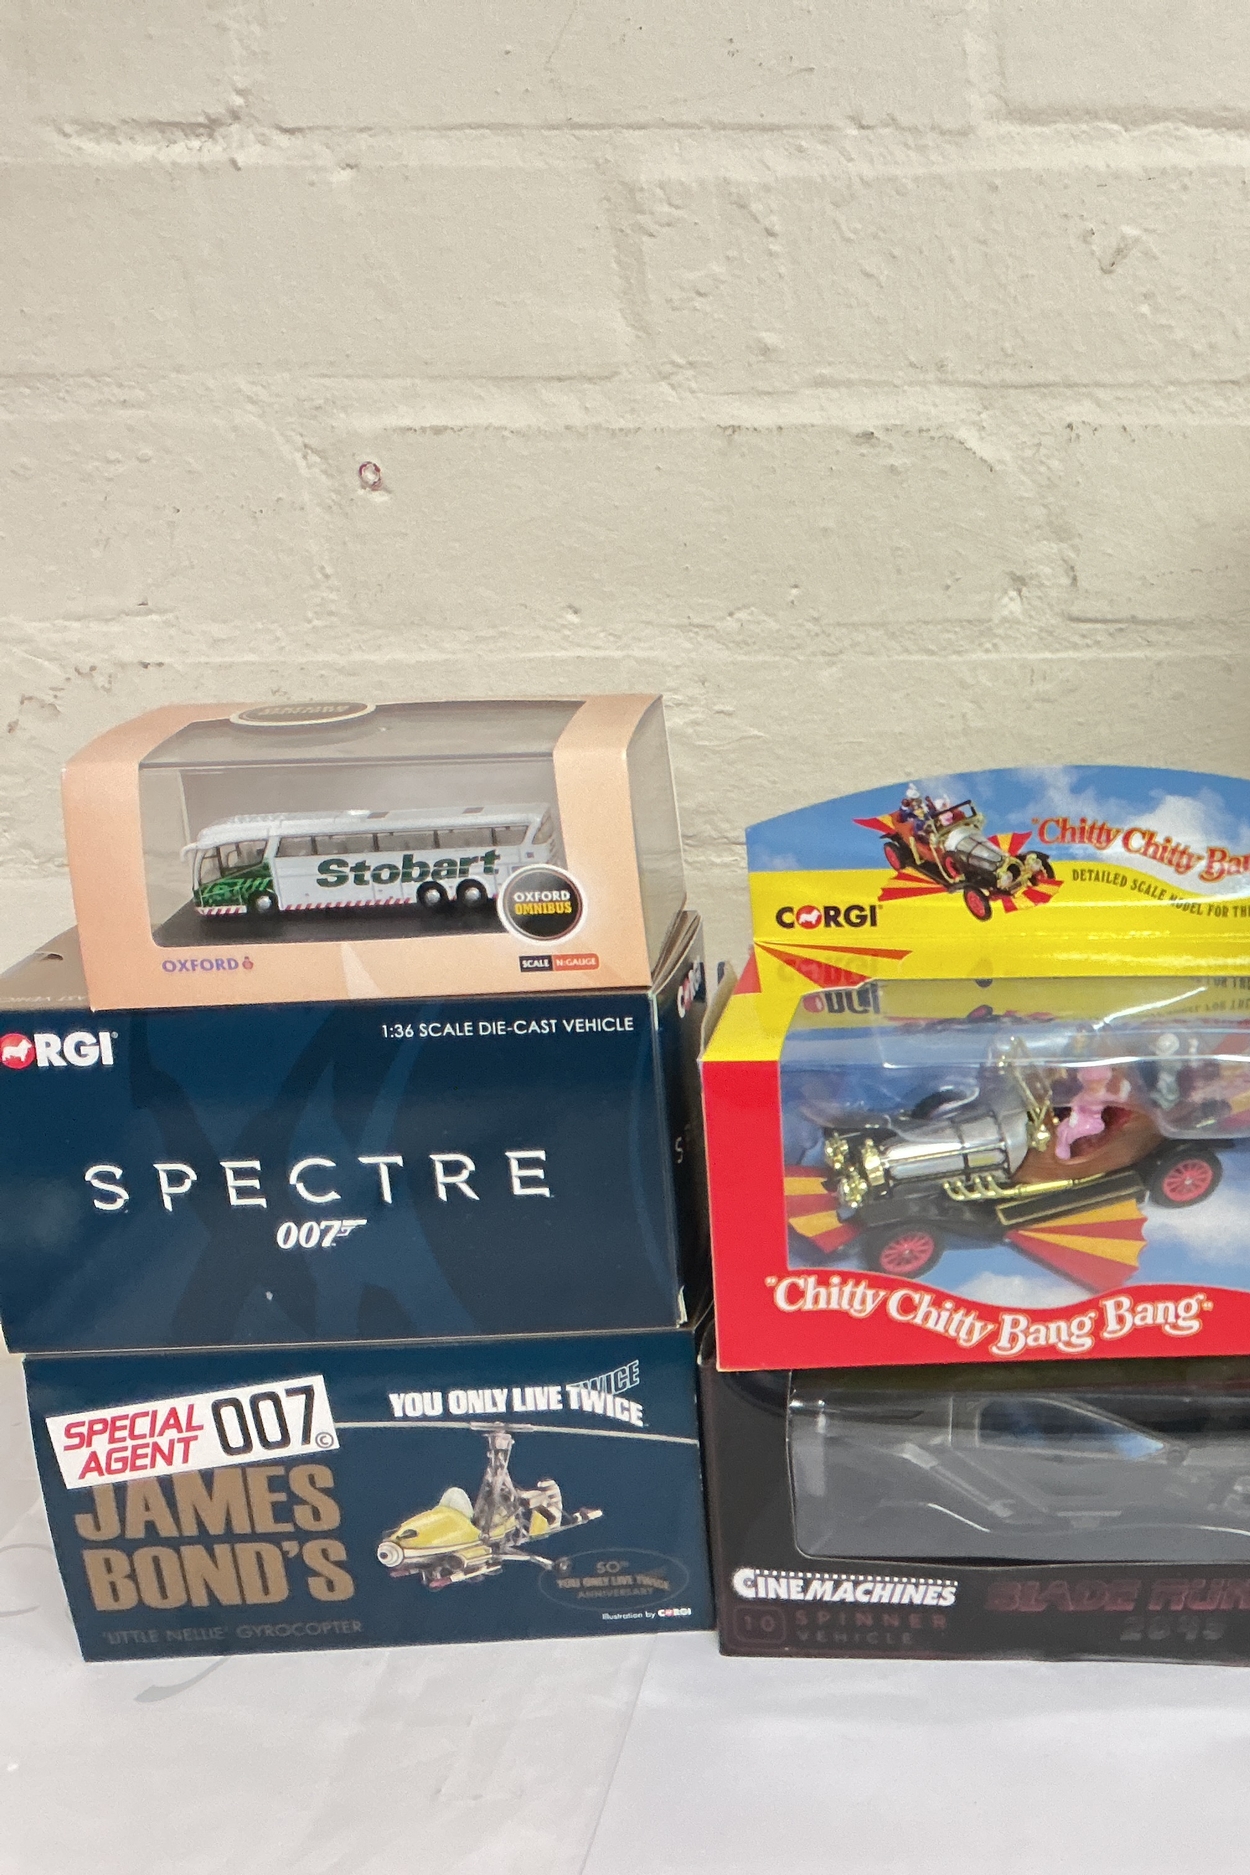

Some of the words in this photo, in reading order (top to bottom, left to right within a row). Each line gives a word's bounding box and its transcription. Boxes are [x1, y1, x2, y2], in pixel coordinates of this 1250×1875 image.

[1121, 827, 1204, 875] Chitty
[316, 849, 501, 888] Stobart
[513, 890, 571, 902] OXFORD
[515, 901, 573, 915] OMNIBUS
[1072, 868, 1128, 888] DETAILED
[1130, 880, 1167, 902] SCALE
[1169, 894, 1204, 916] MODEL
[1207, 902, 1228, 918] FOR
[776, 904, 878, 930] CORGI
[162, 957, 239, 973] OXFORD
[522, 959, 550, 968] SCALE
[381, 1024, 414, 1039] 1:36
[419, 1022, 474, 1038] SCALE
[478, 1019, 558, 1036] DIE-CAST
[562, 1017, 634, 1033] VEHICLE
[84, 1150, 552, 1213] SPECTRE
[276, 1219, 360, 1250] 007
[886, 1288, 996, 1348] Chitty
[989, 1311, 1096, 1356] Bang
[63, 1403, 205, 1452] SPECIAL
[210, 1384, 315, 1457] 007
[388, 1391, 443, 1417] YOU
[448, 1387, 508, 1415] ONLY
[512, 1385, 563, 1412] LIVE
[565, 1384, 644, 1428] TWICE
[78, 1435, 199, 1480] AGENT
[75, 1463, 341, 1542] JAMES
[82, 1538, 355, 1612] BOND'S
[985, 1579, 1142, 1613] BLADE
[235, 1619, 362, 1639] GYROCOPTER
[602, 1610, 643, 1621] Illustration
[645, 1610, 656, 1620] by
[657, 1607, 692, 1617] CORGI
[796, 1609, 947, 1628] SPINNER
[800, 1631, 914, 1645] VEHICLE
